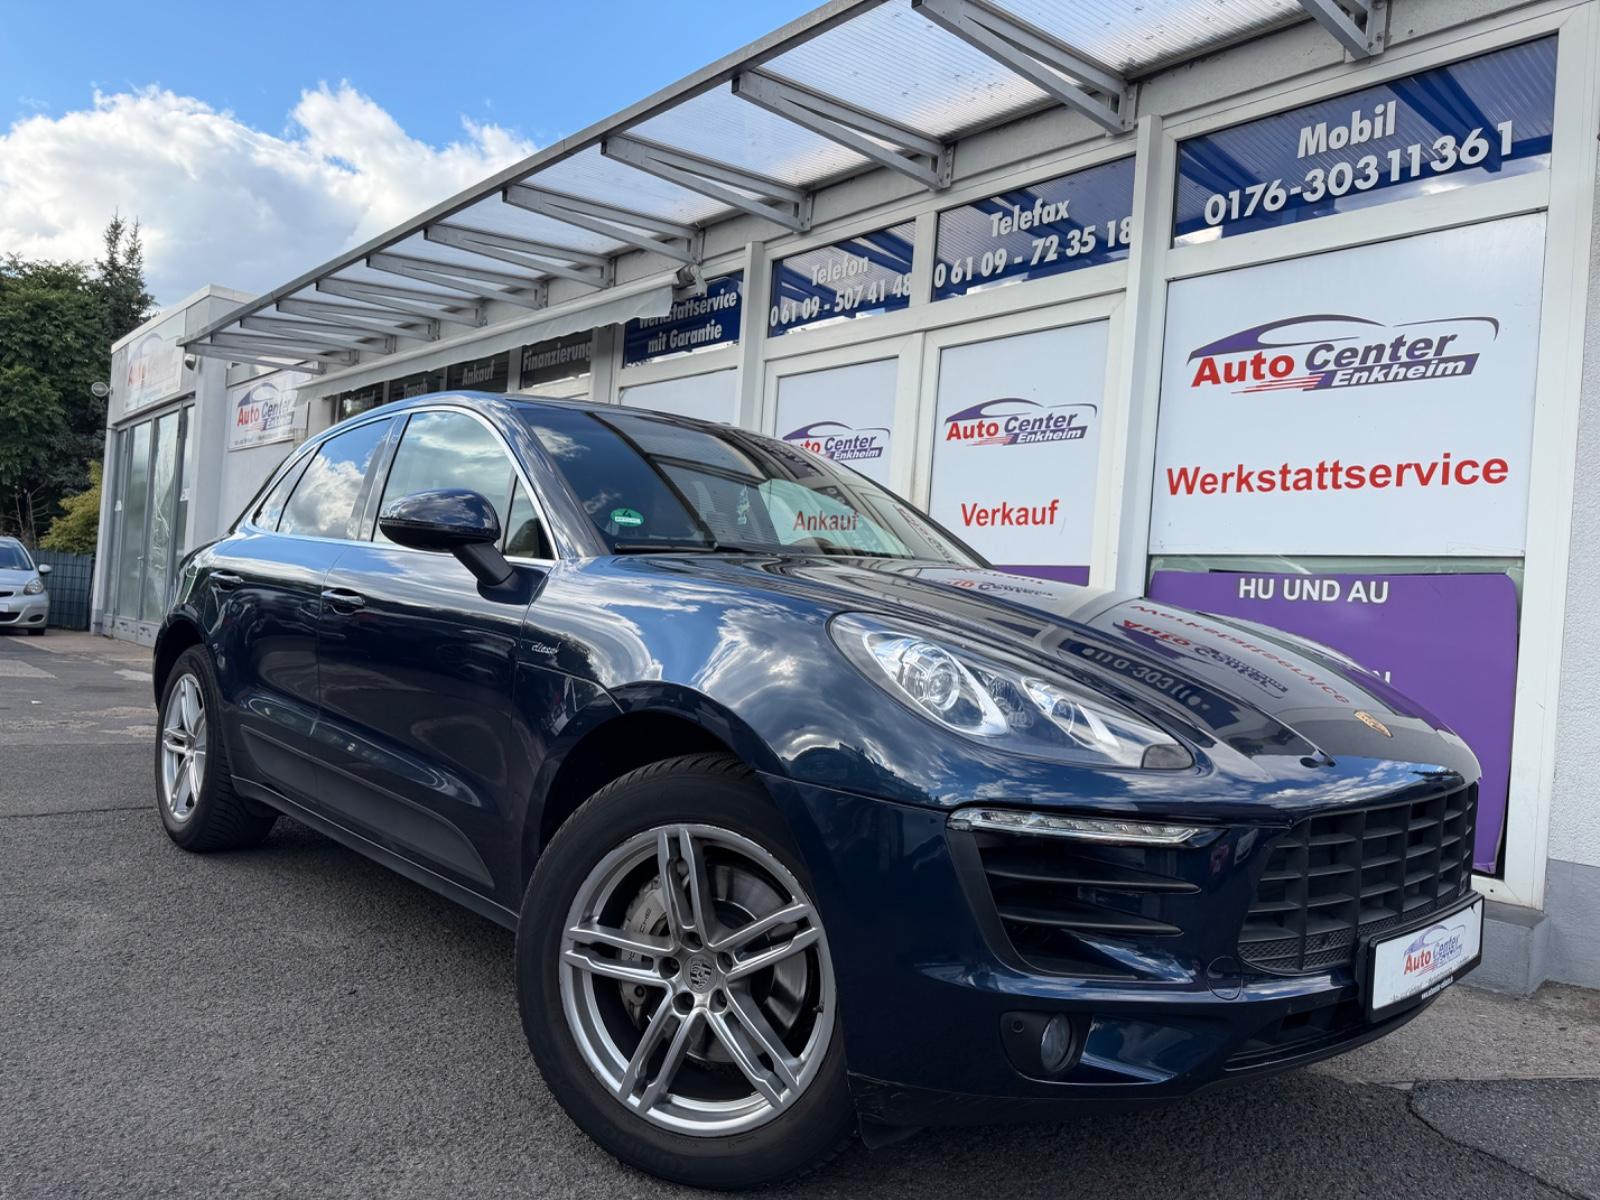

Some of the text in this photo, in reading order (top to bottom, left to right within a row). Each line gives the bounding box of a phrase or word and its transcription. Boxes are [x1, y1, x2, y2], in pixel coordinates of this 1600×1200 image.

[1297, 100, 1397, 158] Mobil
[1204, 120, 1513, 226] 0176-30311361
[990, 198, 1069, 237] Telefax
[1030, 235, 1060, 266] 72
[1065, 225, 1096, 257] 35
[1107, 216, 1132, 248] 18
[811, 256, 869, 286] Telefon
[834, 285, 864, 312] 507
[868, 280, 885, 303] 41
[648, 319, 722, 353] mit Garantie
[523, 342, 592, 372] Finanzierung
[1191, 334, 1458, 388] Auto Center
[1331, 357, 1466, 386] Enkheim
[462, 359, 495, 386] Ankauf
[237, 406, 259, 427] Auto
[946, 412, 1078, 441] Auto Center
[800, 435, 877, 453] to Center
[1016, 429, 1082, 443] Enkheim
[833, 449, 879, 460] Enkheim
[1166, 452, 1509, 496] Werkstattservice
[793, 511, 859, 531] Ankauf
[960, 499, 1060, 527] Verkauf
[1239, 578, 1389, 603] HU UND AU
[1404, 949, 1431, 975] Auto
